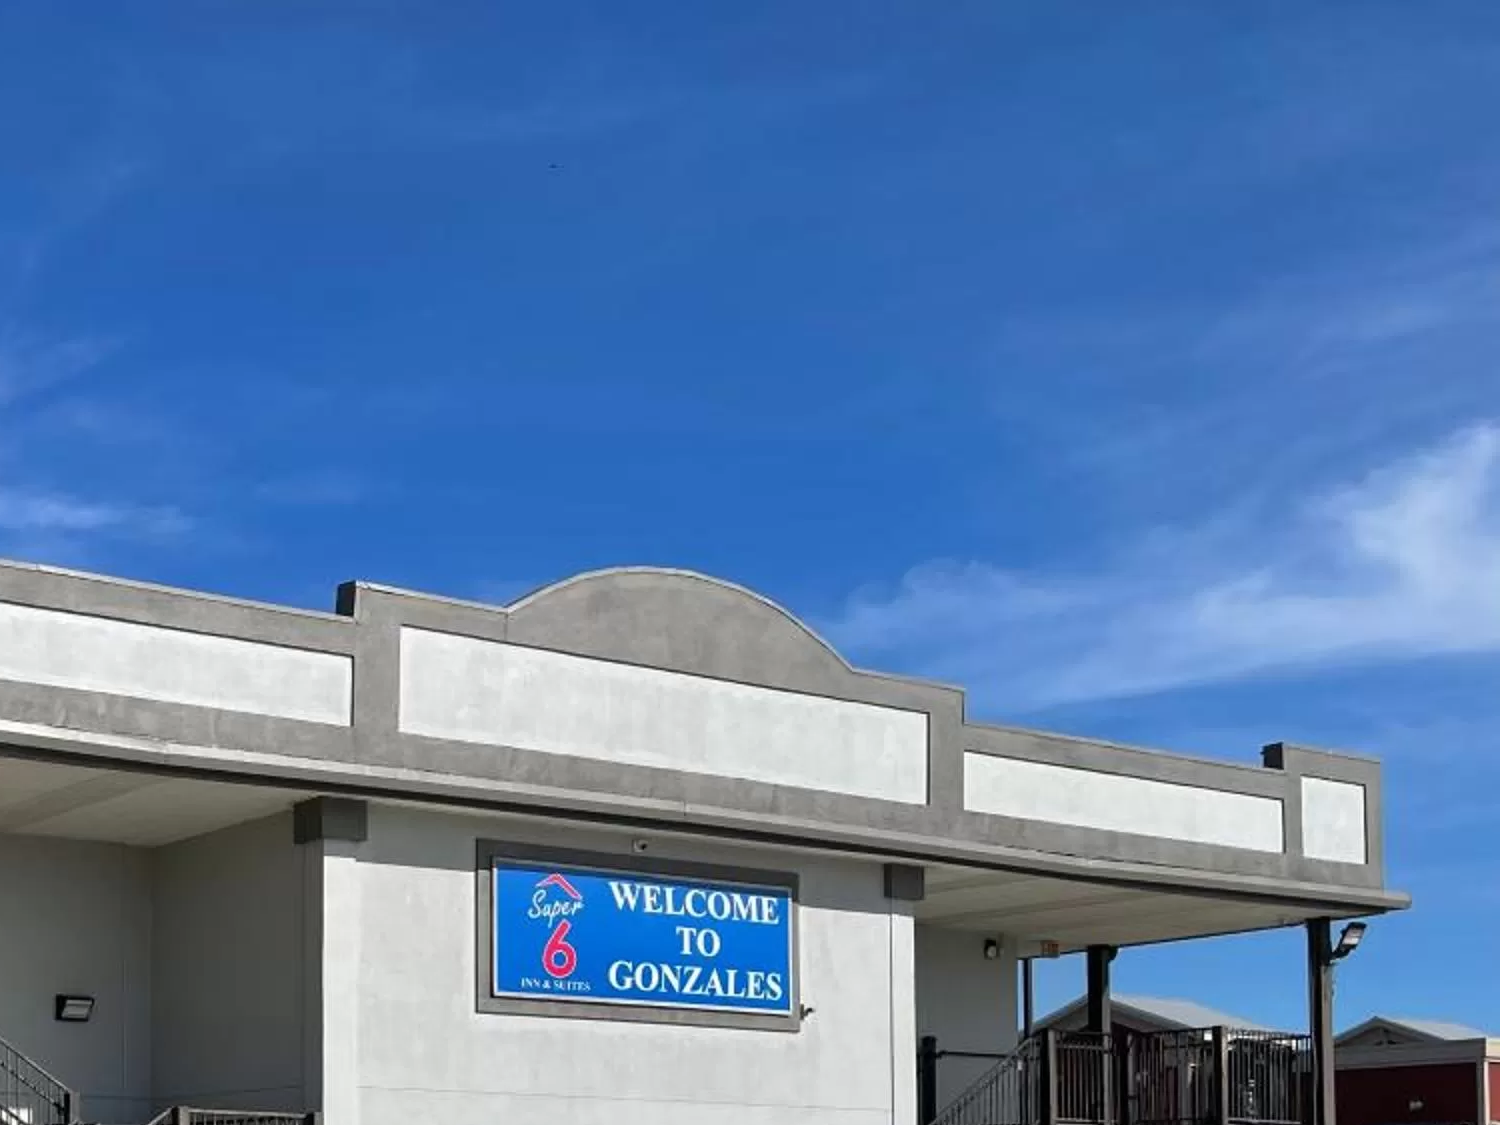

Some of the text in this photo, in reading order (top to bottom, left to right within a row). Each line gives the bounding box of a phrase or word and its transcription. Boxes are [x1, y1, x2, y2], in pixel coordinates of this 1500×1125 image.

[528, 889, 584, 928] Super
[608, 881, 780, 925] WELCOME
[542, 918, 577, 978] 6
[676, 927, 721, 957] TO
[520, 977, 591, 991] INN & SUITES
[608, 961, 782, 1000] GONZALES
